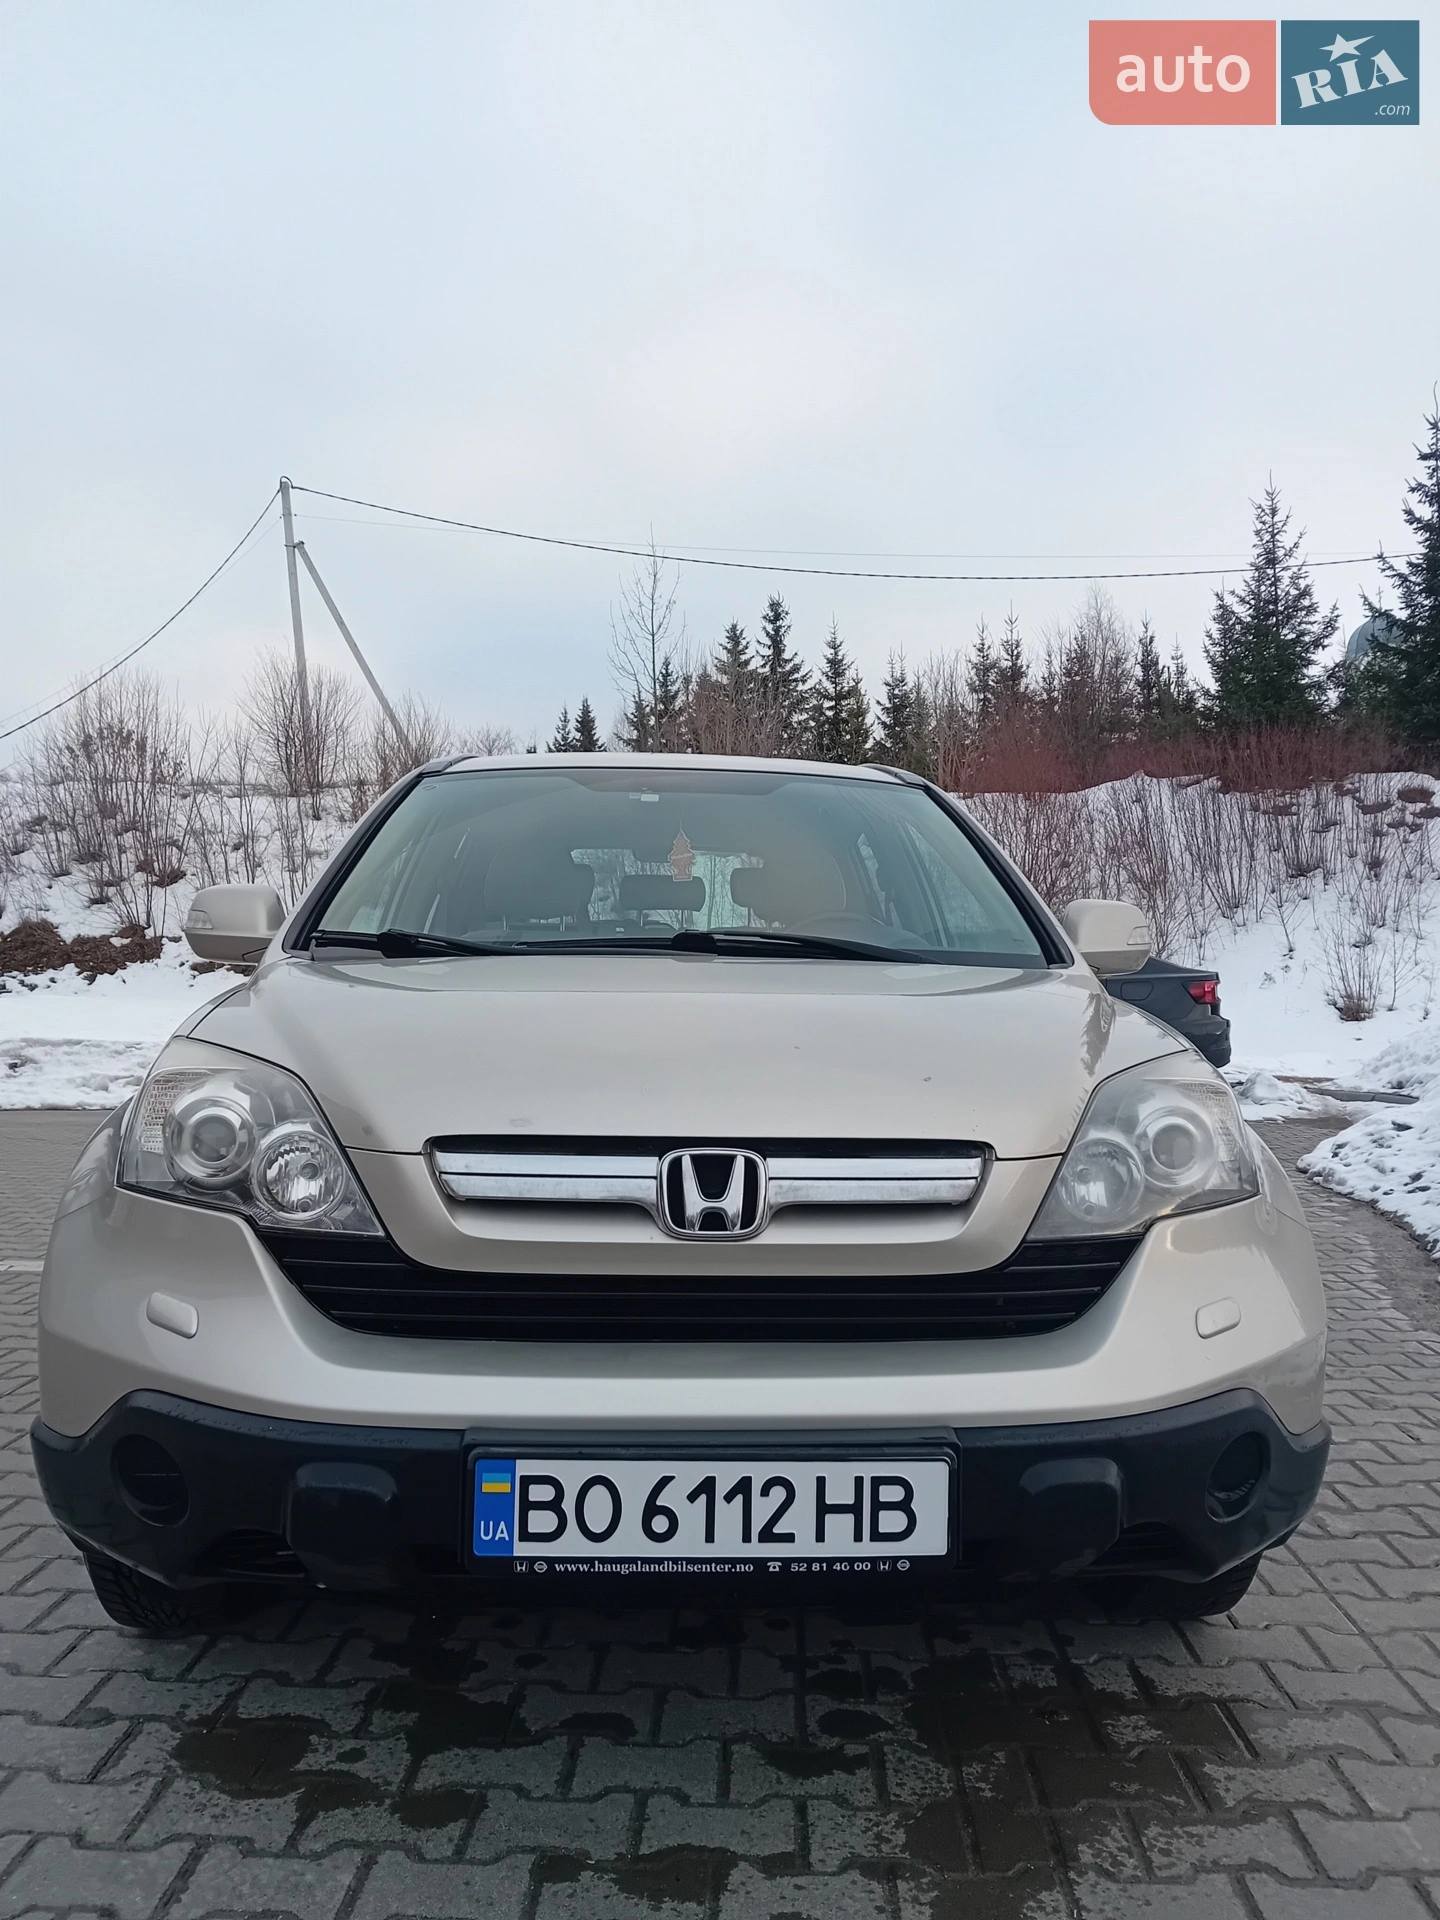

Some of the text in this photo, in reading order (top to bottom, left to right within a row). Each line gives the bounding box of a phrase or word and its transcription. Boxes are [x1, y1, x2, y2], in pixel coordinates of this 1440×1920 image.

[518, 1474, 918, 1544] BO 6112 HB
[479, 1520, 510, 1542] UA
[554, 1560, 871, 1575] www.haugalandbilsenter.no 52 81 40 00
